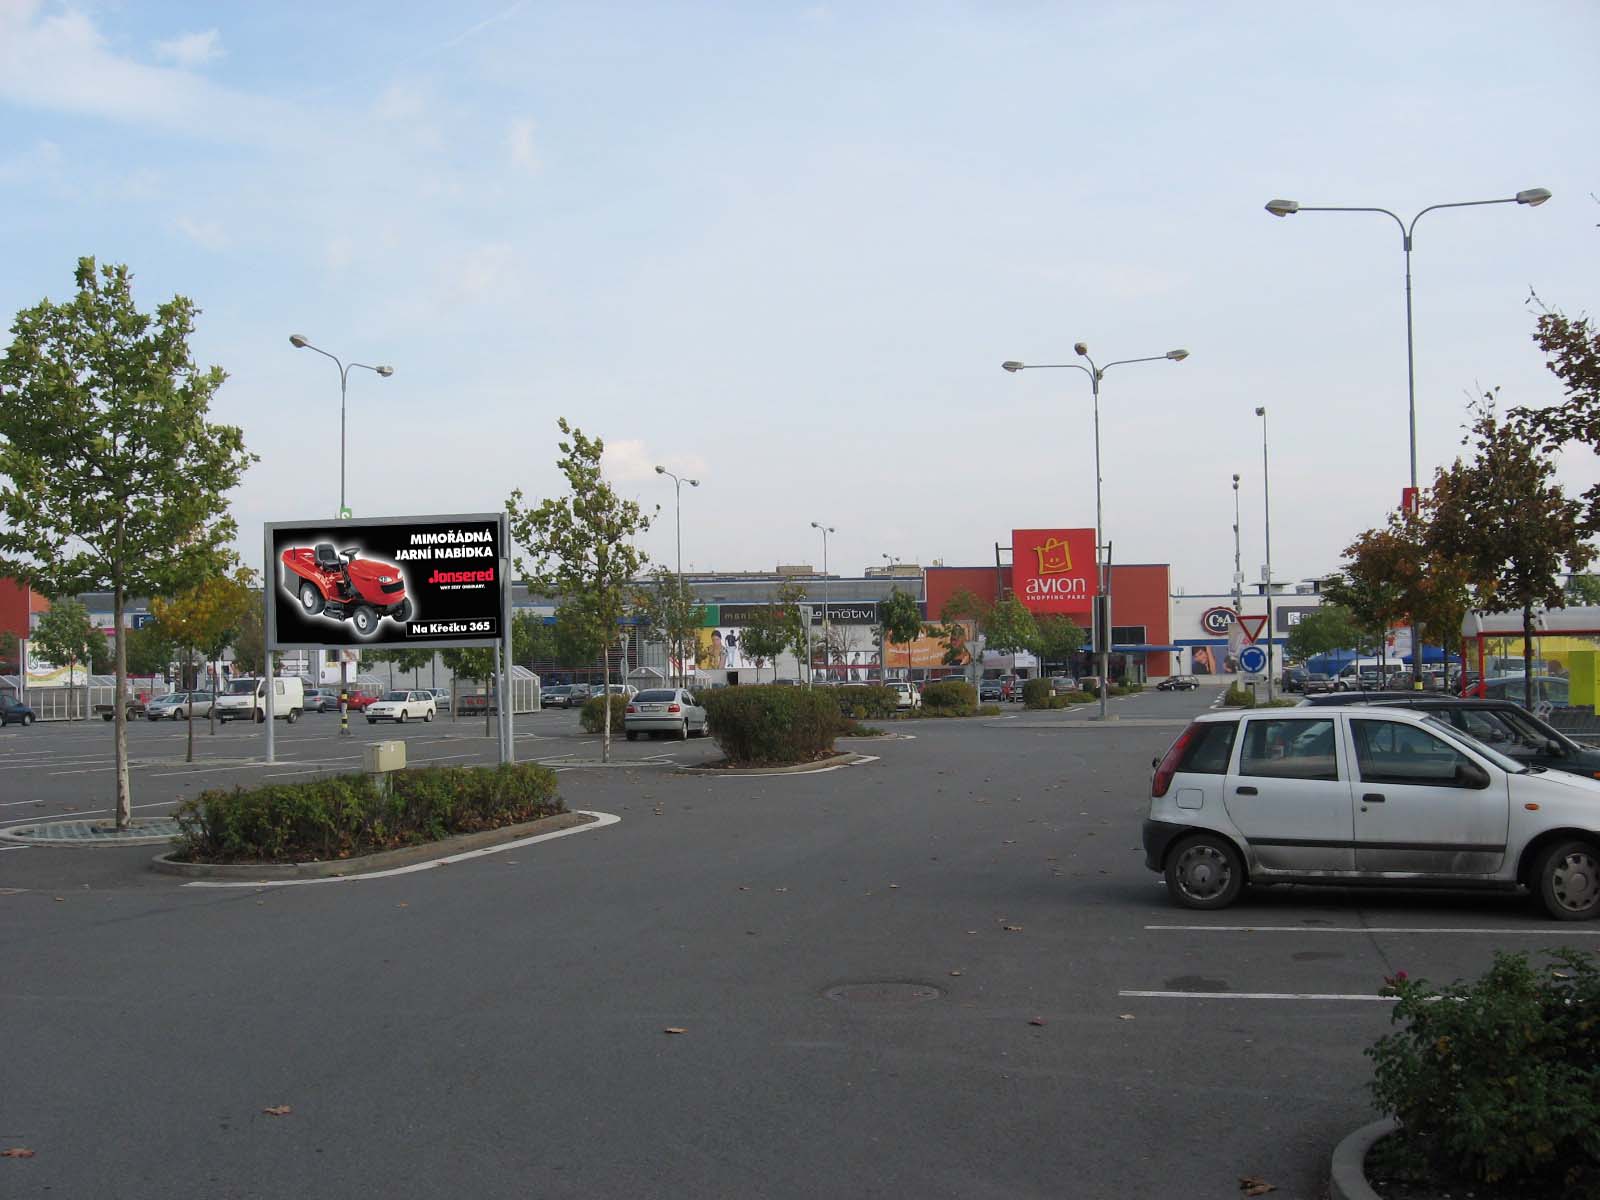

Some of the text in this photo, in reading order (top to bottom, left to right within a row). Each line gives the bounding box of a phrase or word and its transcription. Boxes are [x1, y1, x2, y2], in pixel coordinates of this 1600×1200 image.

[410, 528, 493, 545] MIMOŘÁDNÁ
[395, 545, 494, 560] JARNÍ NABÍDKA
[428, 567, 494, 584] Jonsered
[1025, 577, 1086, 593] avion
[412, 620, 490, 634] Na Křečku 365
[1208, 614, 1232, 627] C&A
